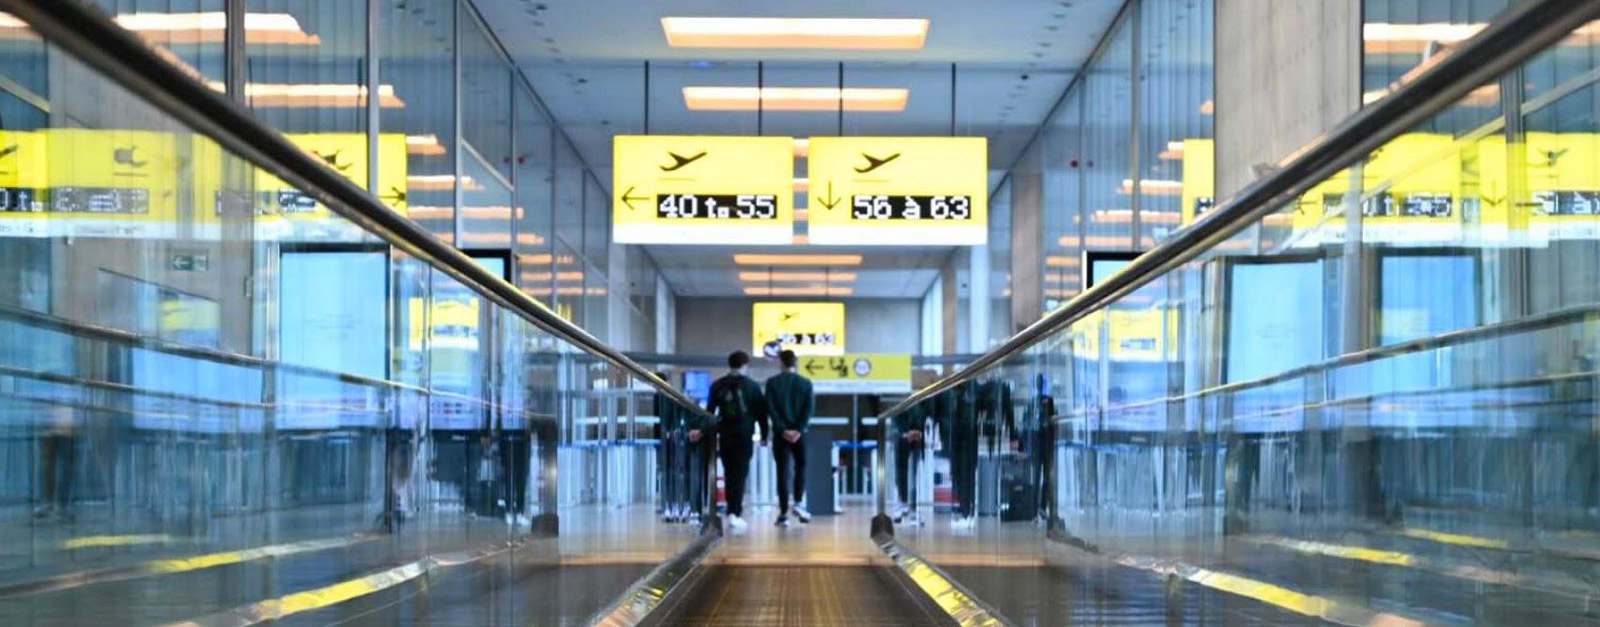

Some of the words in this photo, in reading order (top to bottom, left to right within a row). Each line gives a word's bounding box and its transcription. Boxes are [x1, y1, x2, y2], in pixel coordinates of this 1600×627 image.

[659, 194, 698, 218] 40
[704, 197, 730, 218] to
[736, 195, 775, 219] 55
[853, 195, 892, 219] 56
[902, 195, 921, 219] à
[930, 195, 969, 219] 63
